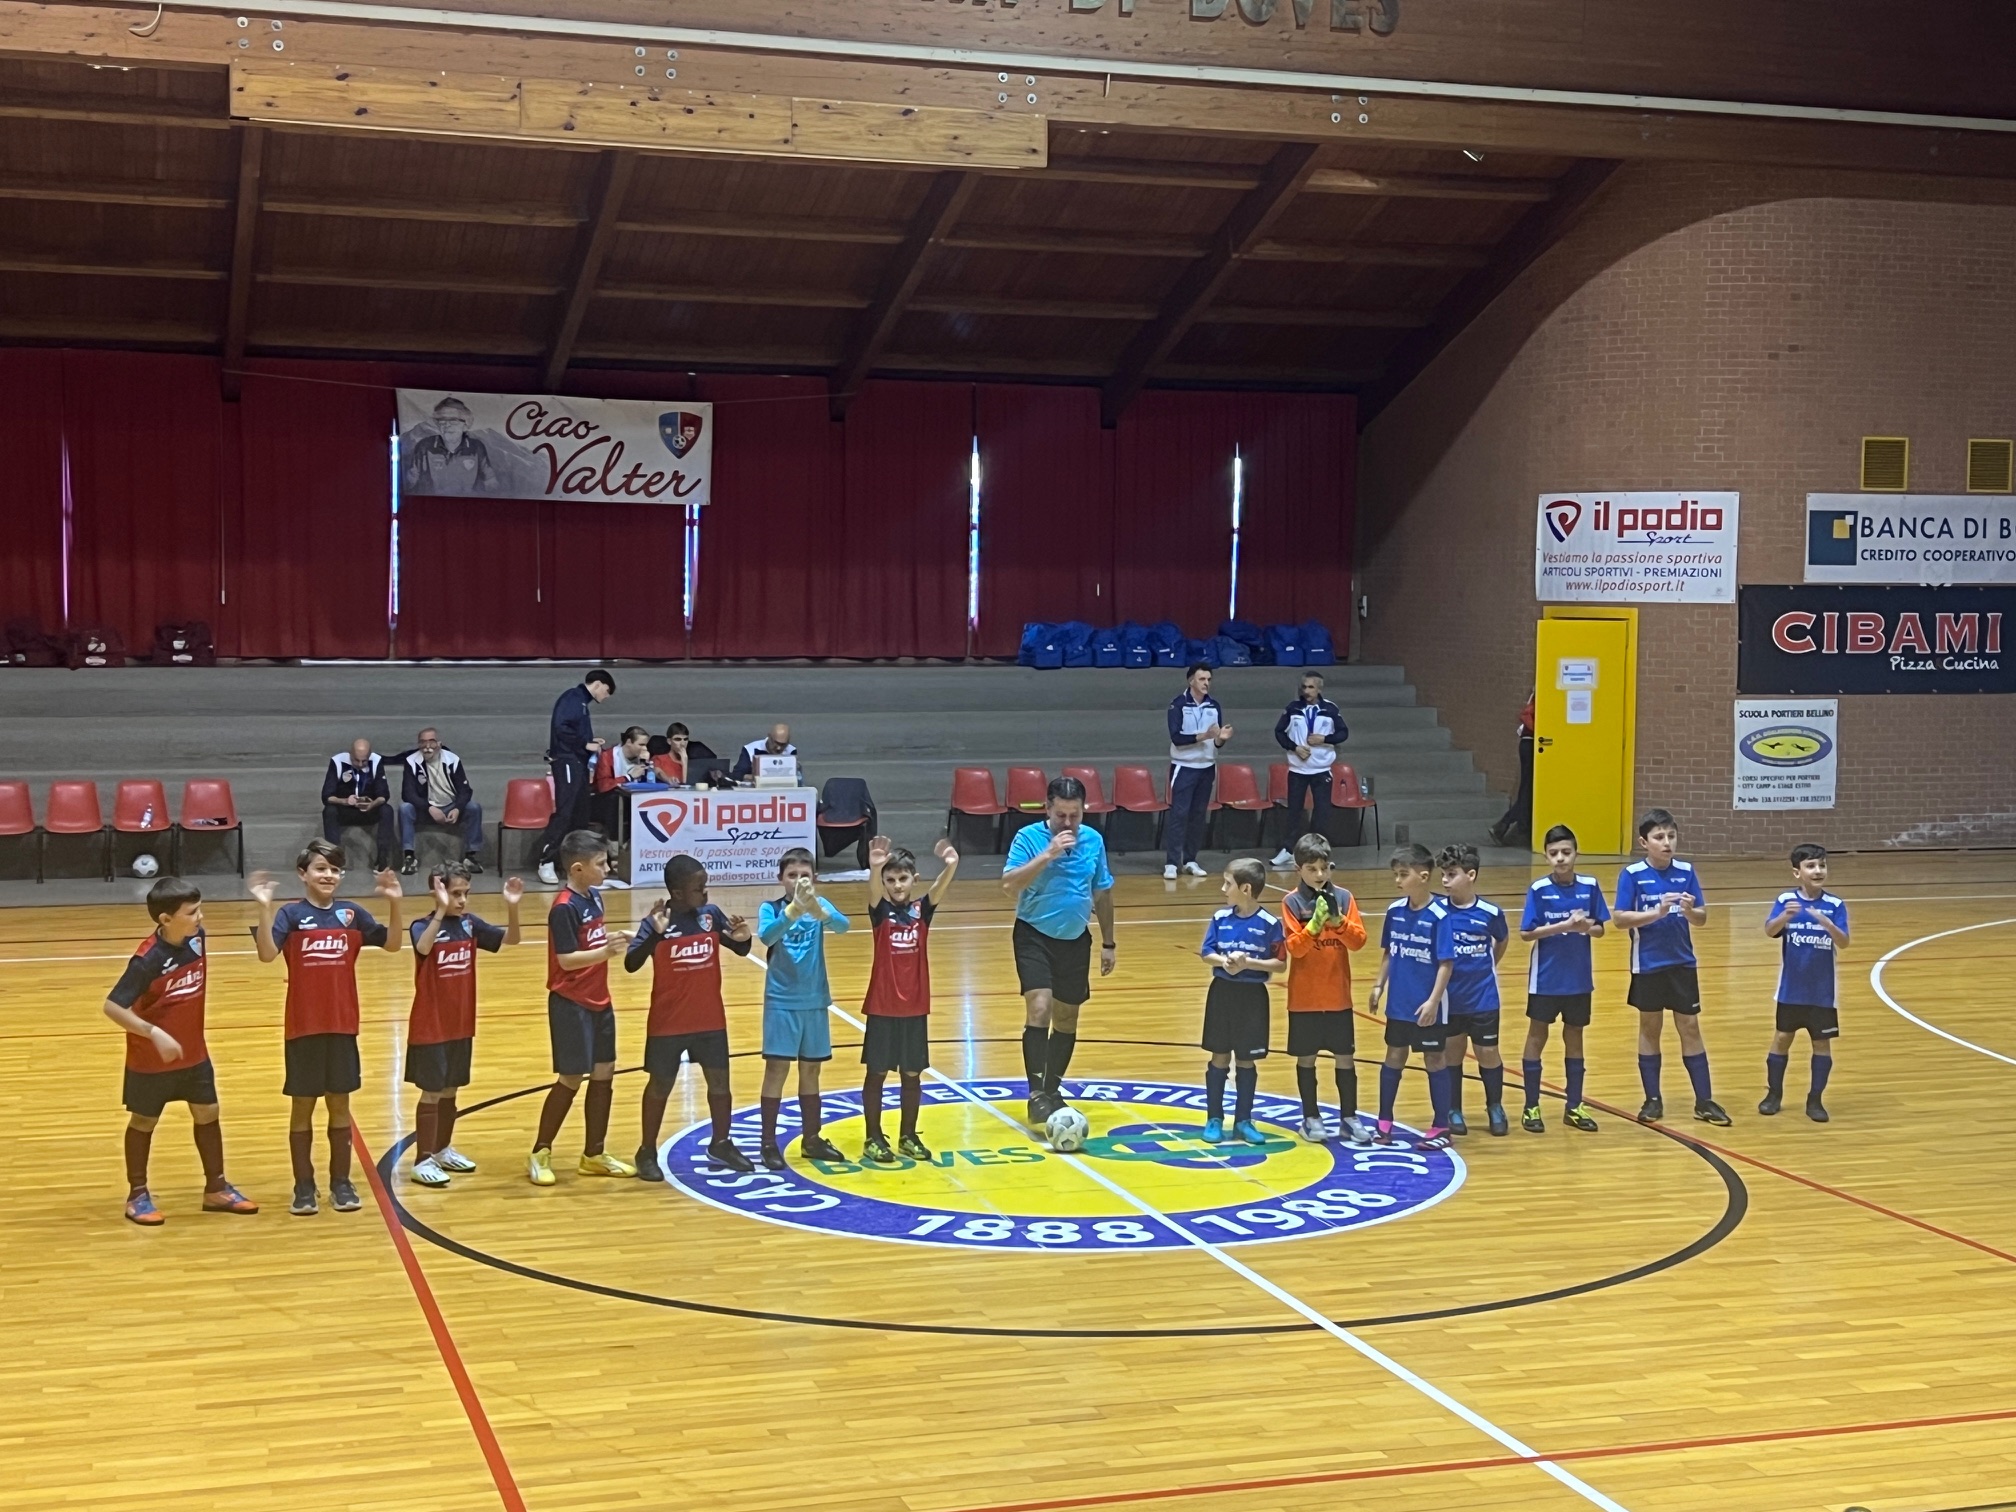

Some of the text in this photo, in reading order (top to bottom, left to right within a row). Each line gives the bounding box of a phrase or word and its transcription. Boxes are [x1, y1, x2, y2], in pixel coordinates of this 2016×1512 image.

[505, 400, 600, 441] Ciao
[532, 436, 702, 498] Valter
[1593, 500, 1723, 538] il podio
[1860, 516, 2016, 540] BANCA DI B
[1646, 530, 1693, 546] Sport
[1542, 551, 1723, 567] Vestiamo la passione sportiva
[1860, 548, 2016, 562] CREDITO COOPERATIVO
[1542, 566, 1582, 577] ARTICOLI
[1584, 567, 1634, 578] SPORTIVI
[1644, 567, 1723, 578] PREMIAZIONI
[1565, 579, 1685, 594] www.ilpodiosport.it
[1772, 611, 2003, 654] CIBAMI
[1890, 655, 2000, 671] Pizza Cucina
[1739, 709, 1834, 718] SCUOLA PORTIERI BELLINO
[693, 796, 807, 831] il podio
[727, 827, 782, 845] Sport
[707, 846, 757, 859] passione
[708, 871, 775, 883] podiosport.it
[1791, 931, 1833, 947] Locanda
[921, 1085, 1014, 1102] ED
[907, 1188, 1398, 1245] 1888 1988
